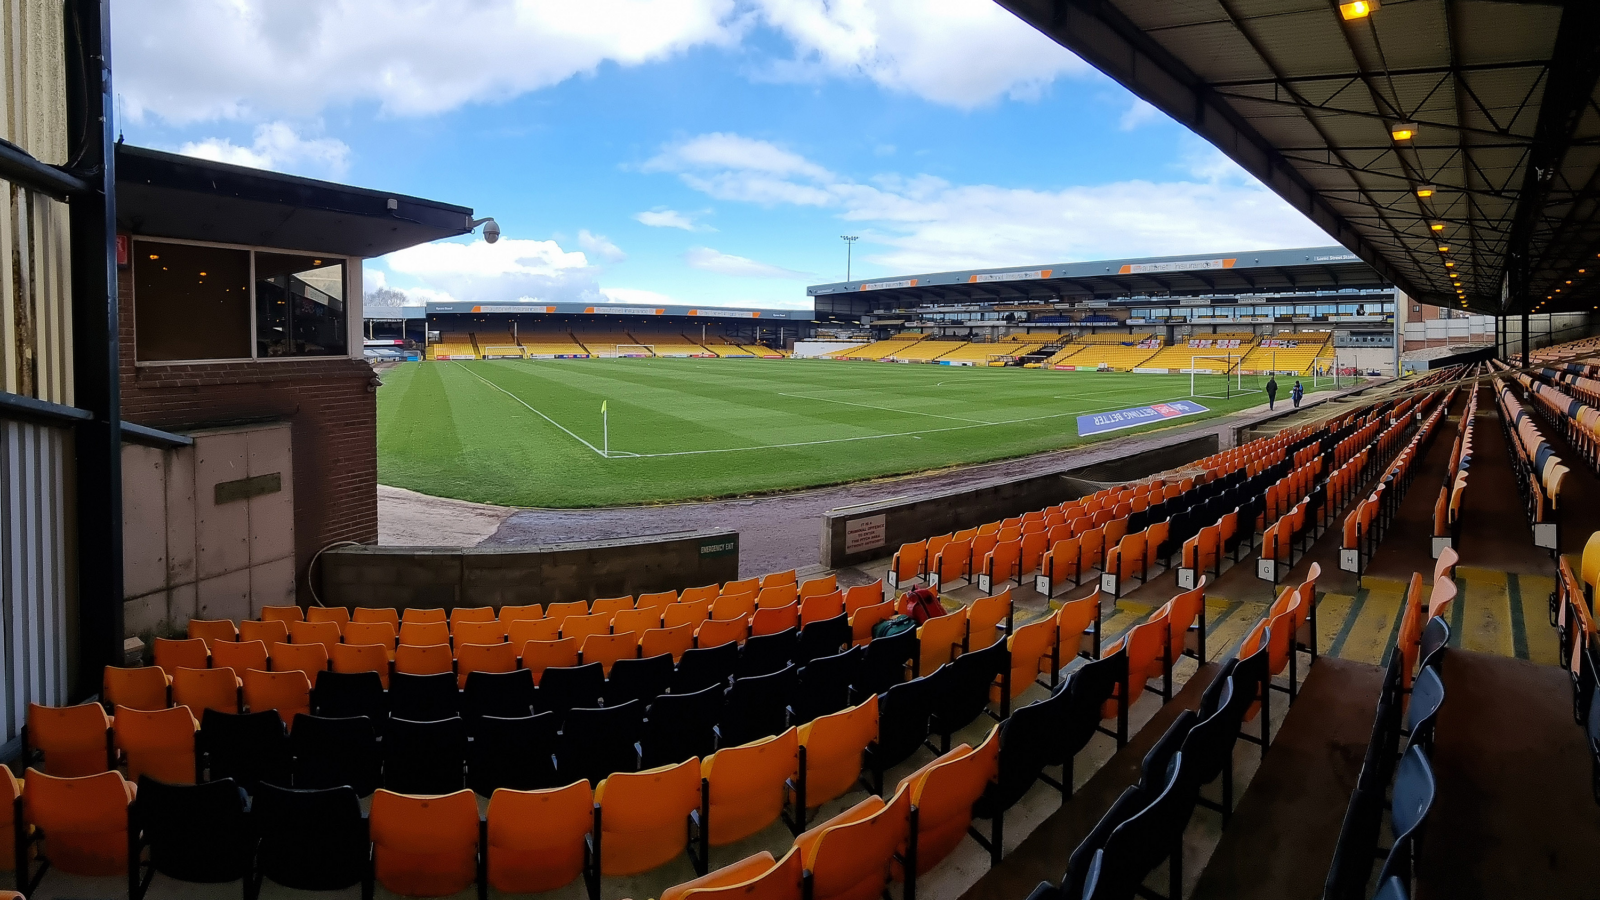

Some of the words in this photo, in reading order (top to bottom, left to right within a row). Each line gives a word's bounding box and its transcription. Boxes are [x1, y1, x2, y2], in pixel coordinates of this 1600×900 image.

[1174, 261, 1211, 271] insurance
[1093, 412, 1125, 426] BETTER
[1123, 408, 1157, 421] BETTING
[701, 544, 725, 554] EMERGENCY
[725, 542, 734, 550] EXIT
[1263, 566, 1270, 574] G
